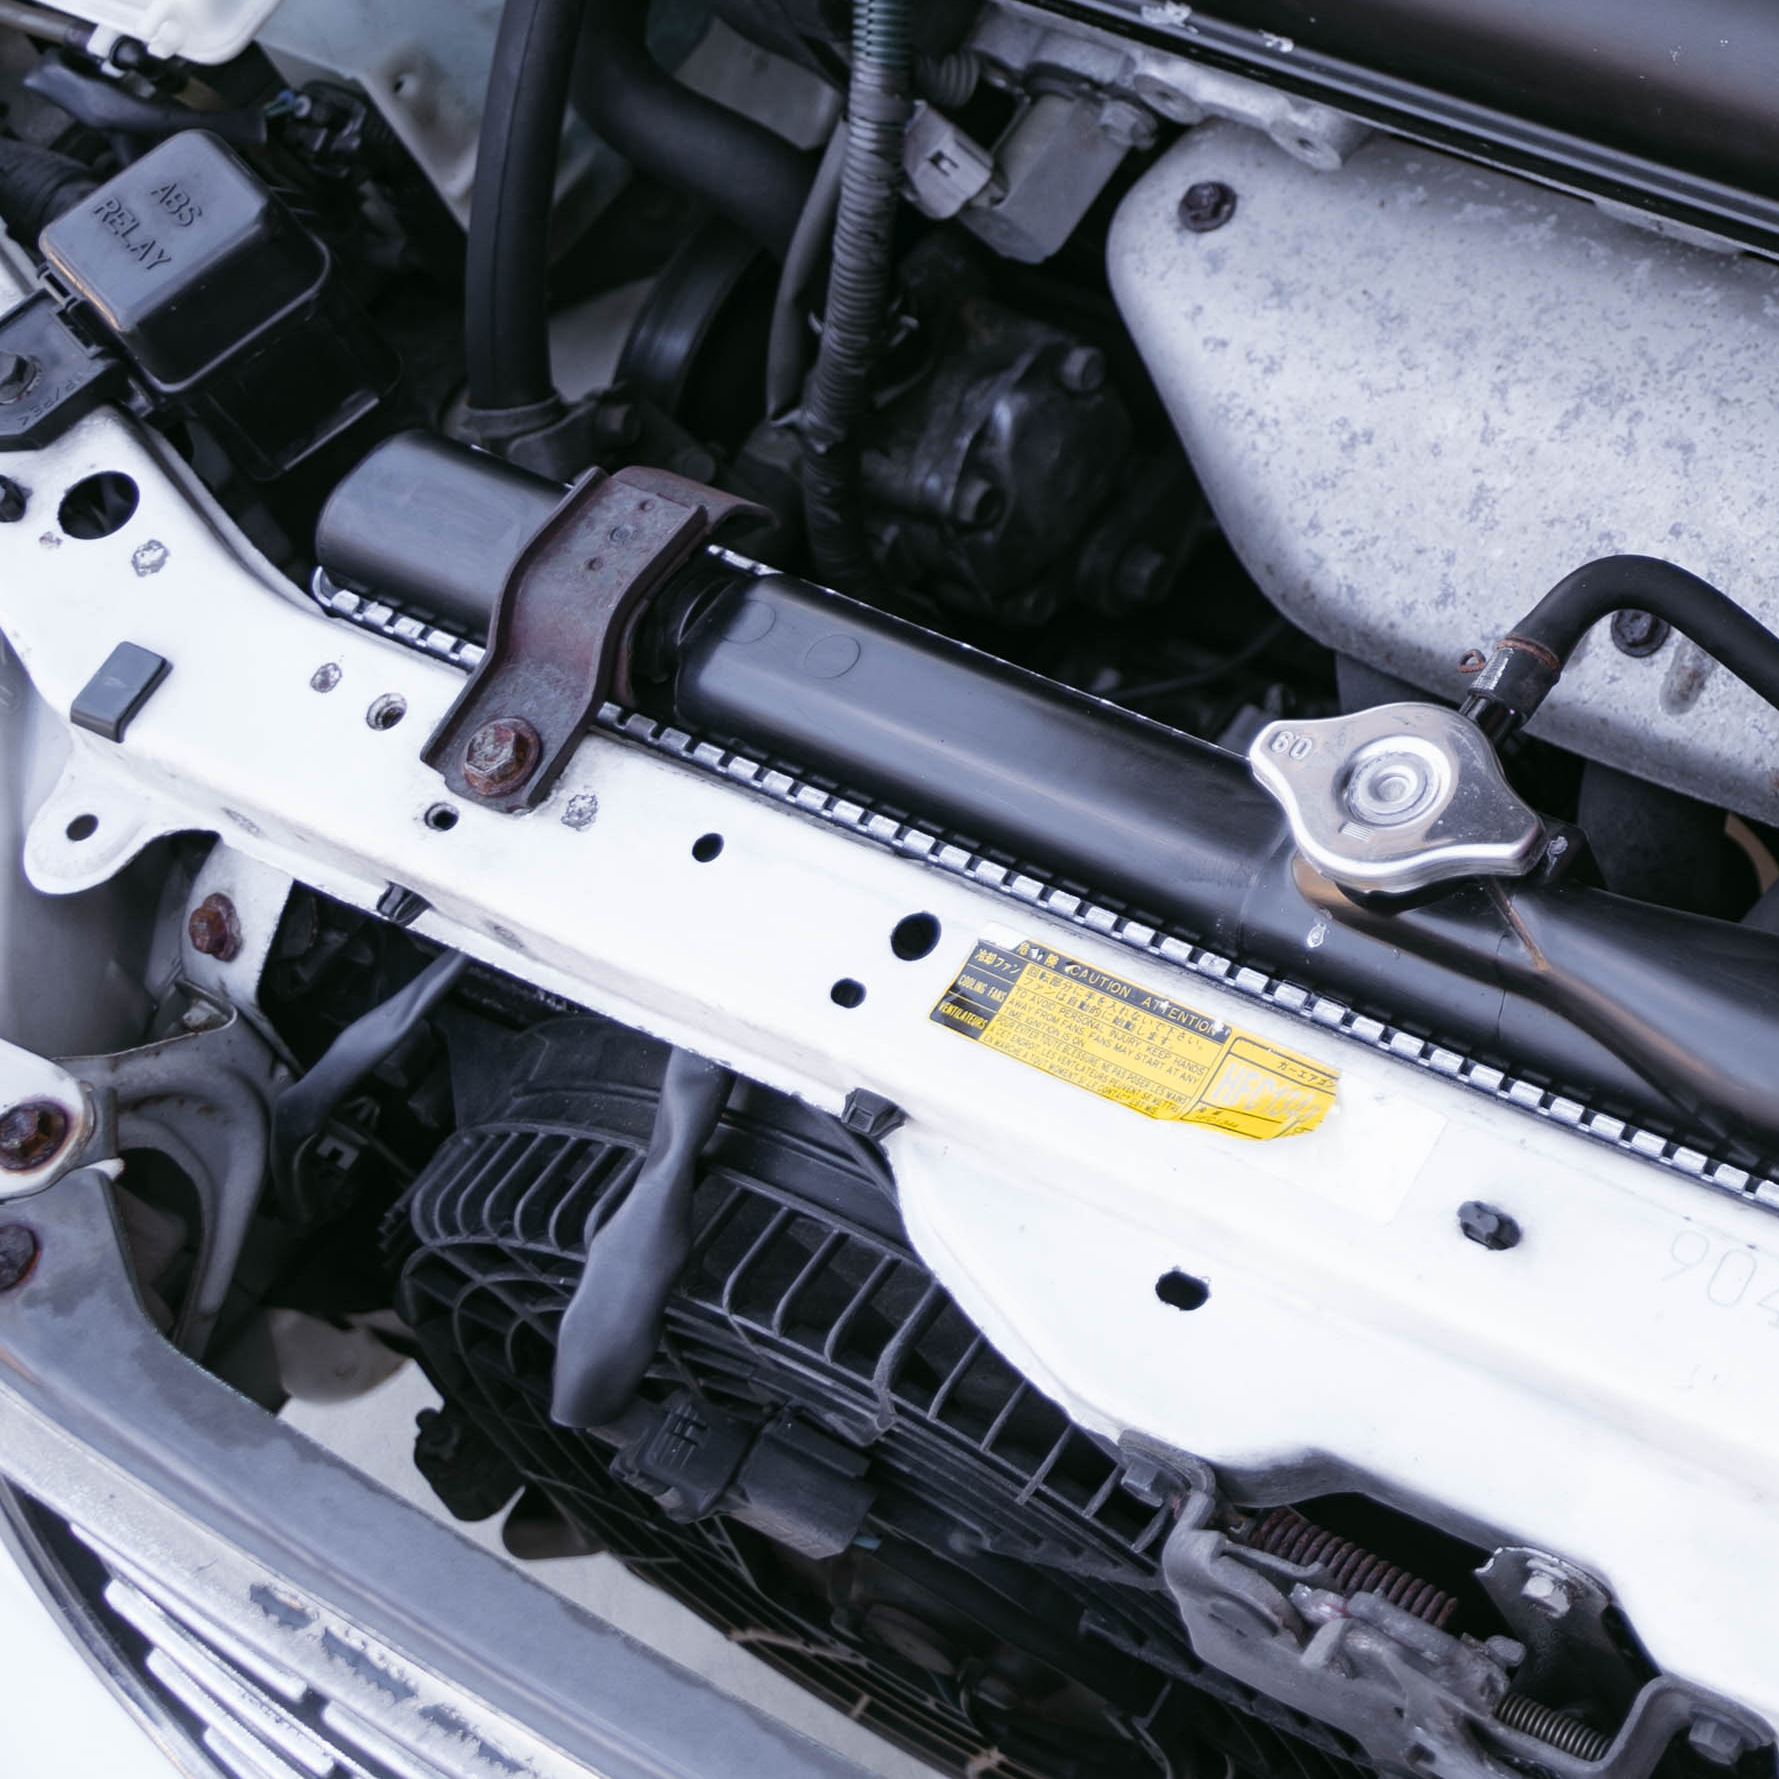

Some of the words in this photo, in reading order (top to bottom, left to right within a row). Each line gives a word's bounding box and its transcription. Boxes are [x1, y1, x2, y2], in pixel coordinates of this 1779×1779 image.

[151, 182, 203, 228] ABS
[93, 196, 173, 271] RELAY
[974, 948, 1023, 975] 冷却ファン
[957, 973, 989, 996] COOLING
[987, 984, 1008, 1005] FANS
[1070, 964, 1132, 998] CAUTION
[1141, 996, 1218, 1037] ATTENTION
[937, 1000, 989, 1031] VENTILATEURS
[1001, 1006, 1025, 1021] TIME
[1022, 1015, 1062, 1036] IGNITION
[1013, 987, 1028, 999] TO
[1029, 994, 1059, 1012] AVOID
[1056, 1006, 1108, 1033] PERSONAL
[1143, 1044, 1173, 1062] KEEP
[1171, 1056, 1206, 1076] HANDS
[1007, 997, 1034, 1013] AWAY
[1033, 1007, 1060, 1024] FROM
[1086, 1030, 1114, 1048] FANS
[1112, 1041, 1134, 1056] MAY
[1133, 1051, 1166, 1070] START
[1164, 1065, 1179, 1076] AT
[1178, 1071, 1199, 1085] ANY
